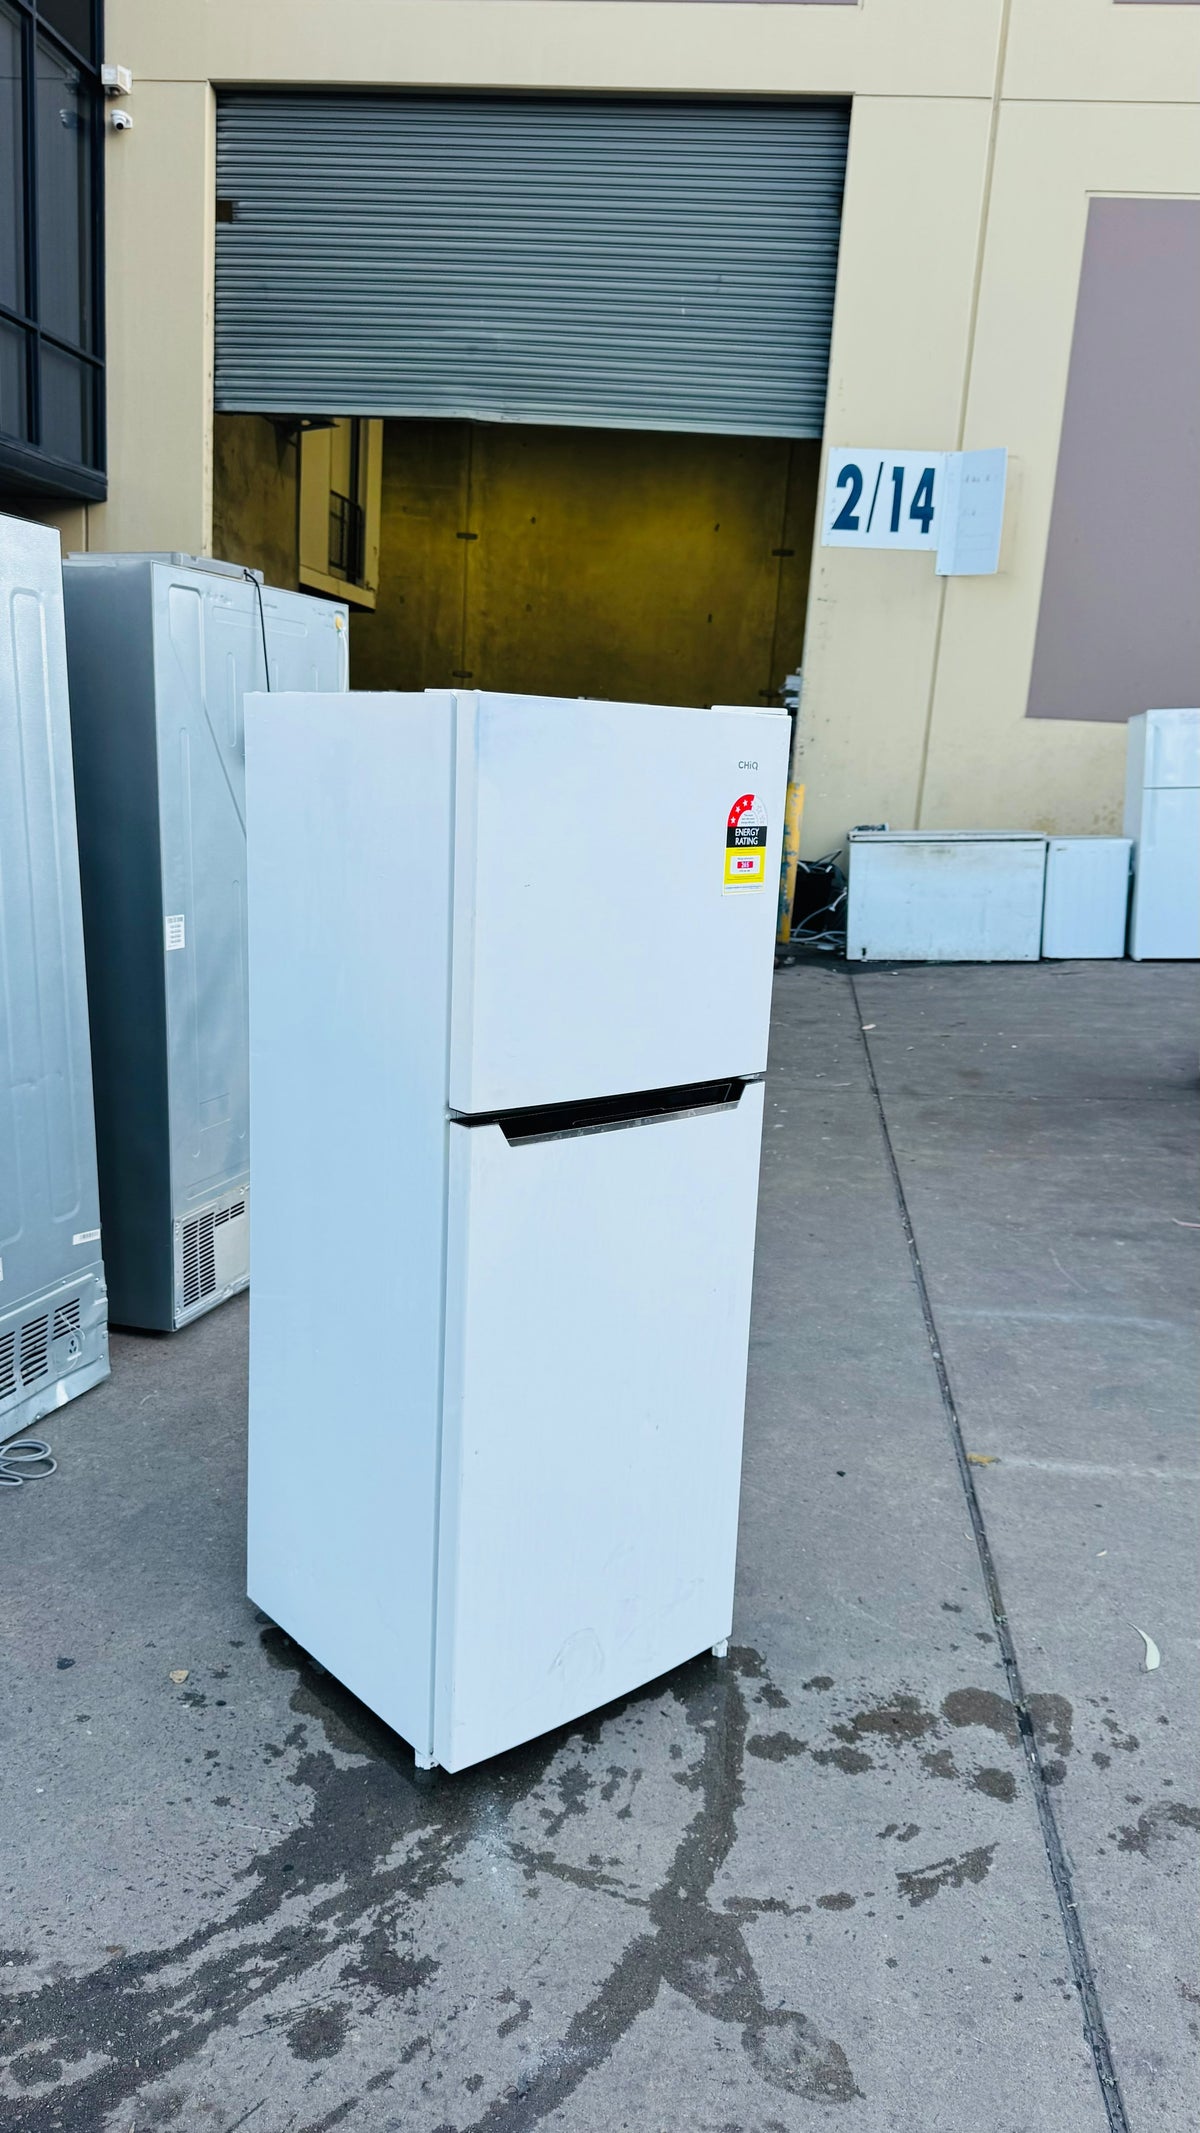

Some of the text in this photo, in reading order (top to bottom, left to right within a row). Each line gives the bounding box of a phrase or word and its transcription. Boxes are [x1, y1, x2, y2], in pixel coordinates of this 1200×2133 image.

[831, 461, 936, 533] 2/14
[738, 761, 759, 770] CHiQ
[735, 828, 759, 837] ENERGY
[735, 836, 759, 846] RATING
